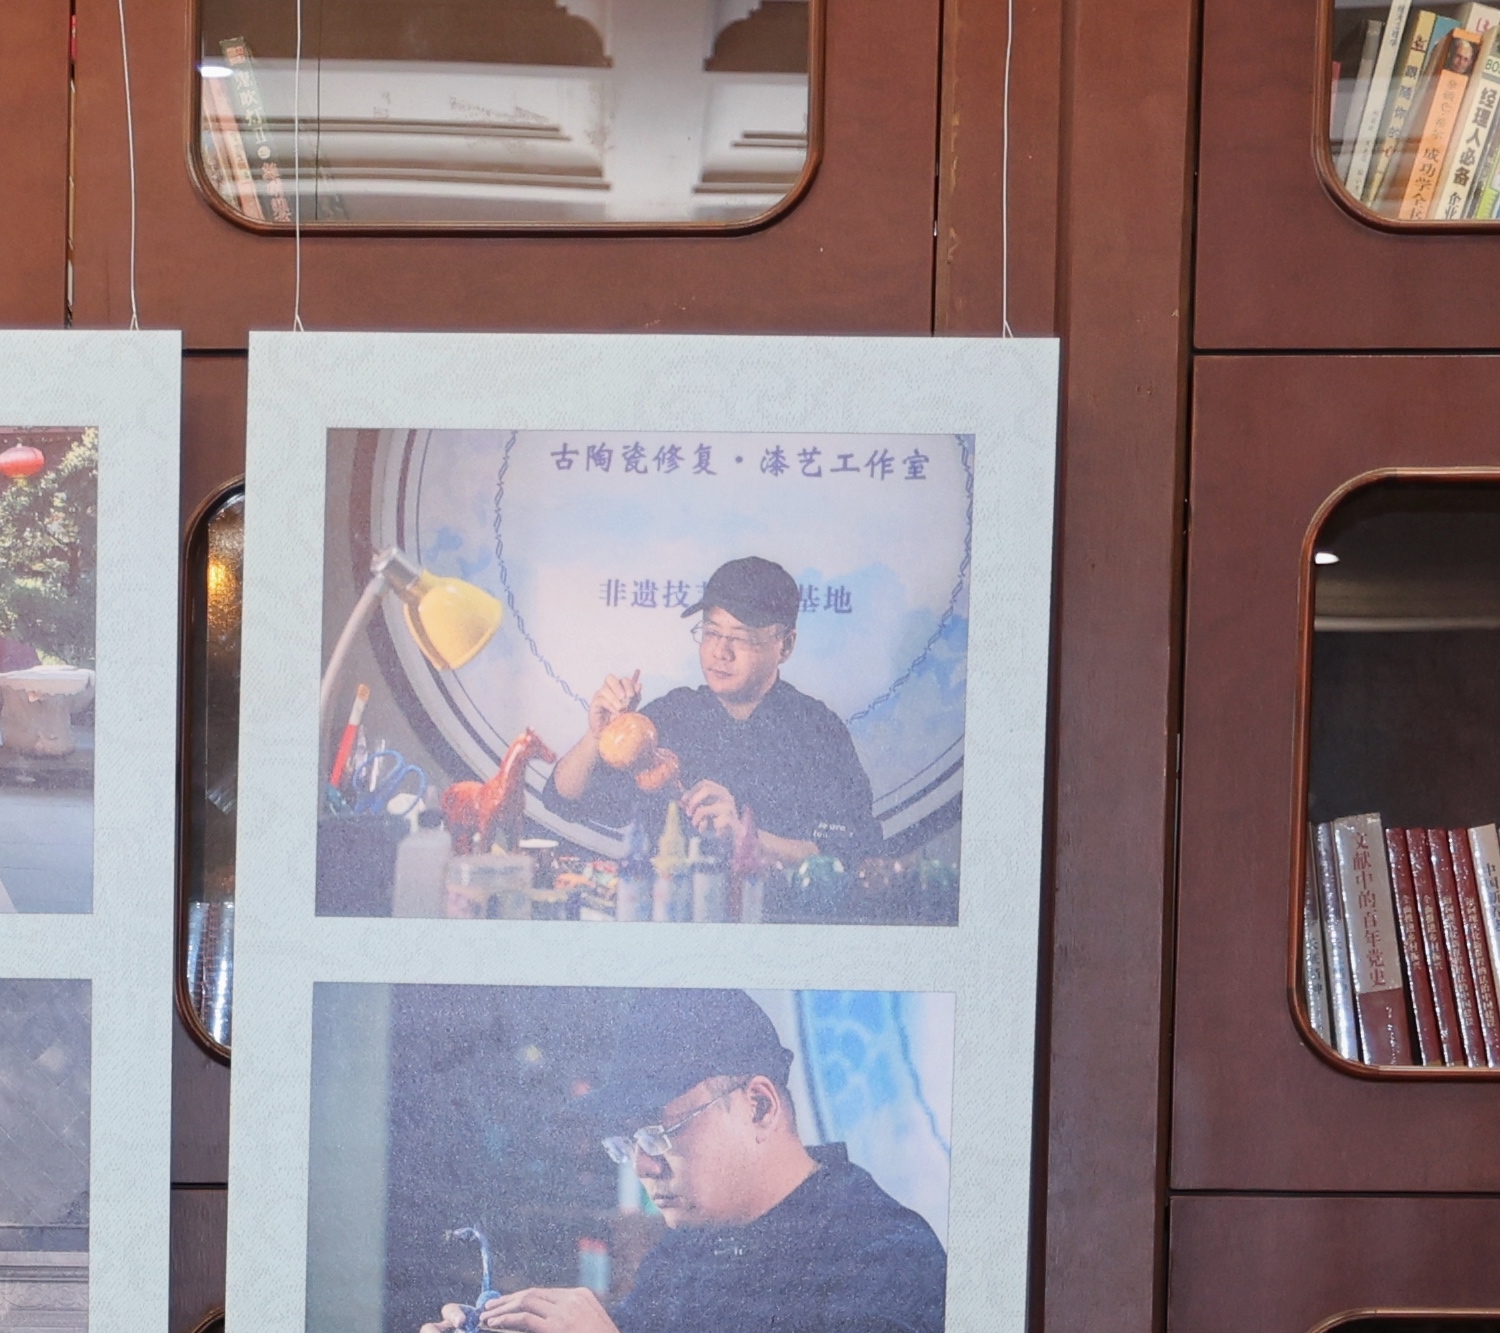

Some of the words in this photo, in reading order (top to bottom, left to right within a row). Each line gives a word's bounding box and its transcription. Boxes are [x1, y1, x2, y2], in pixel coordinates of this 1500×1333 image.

[550, 443, 931, 481] 古陶瓷修复·漆艺工作室
[1353, 832, 1387, 987] 文献中的百年党史
